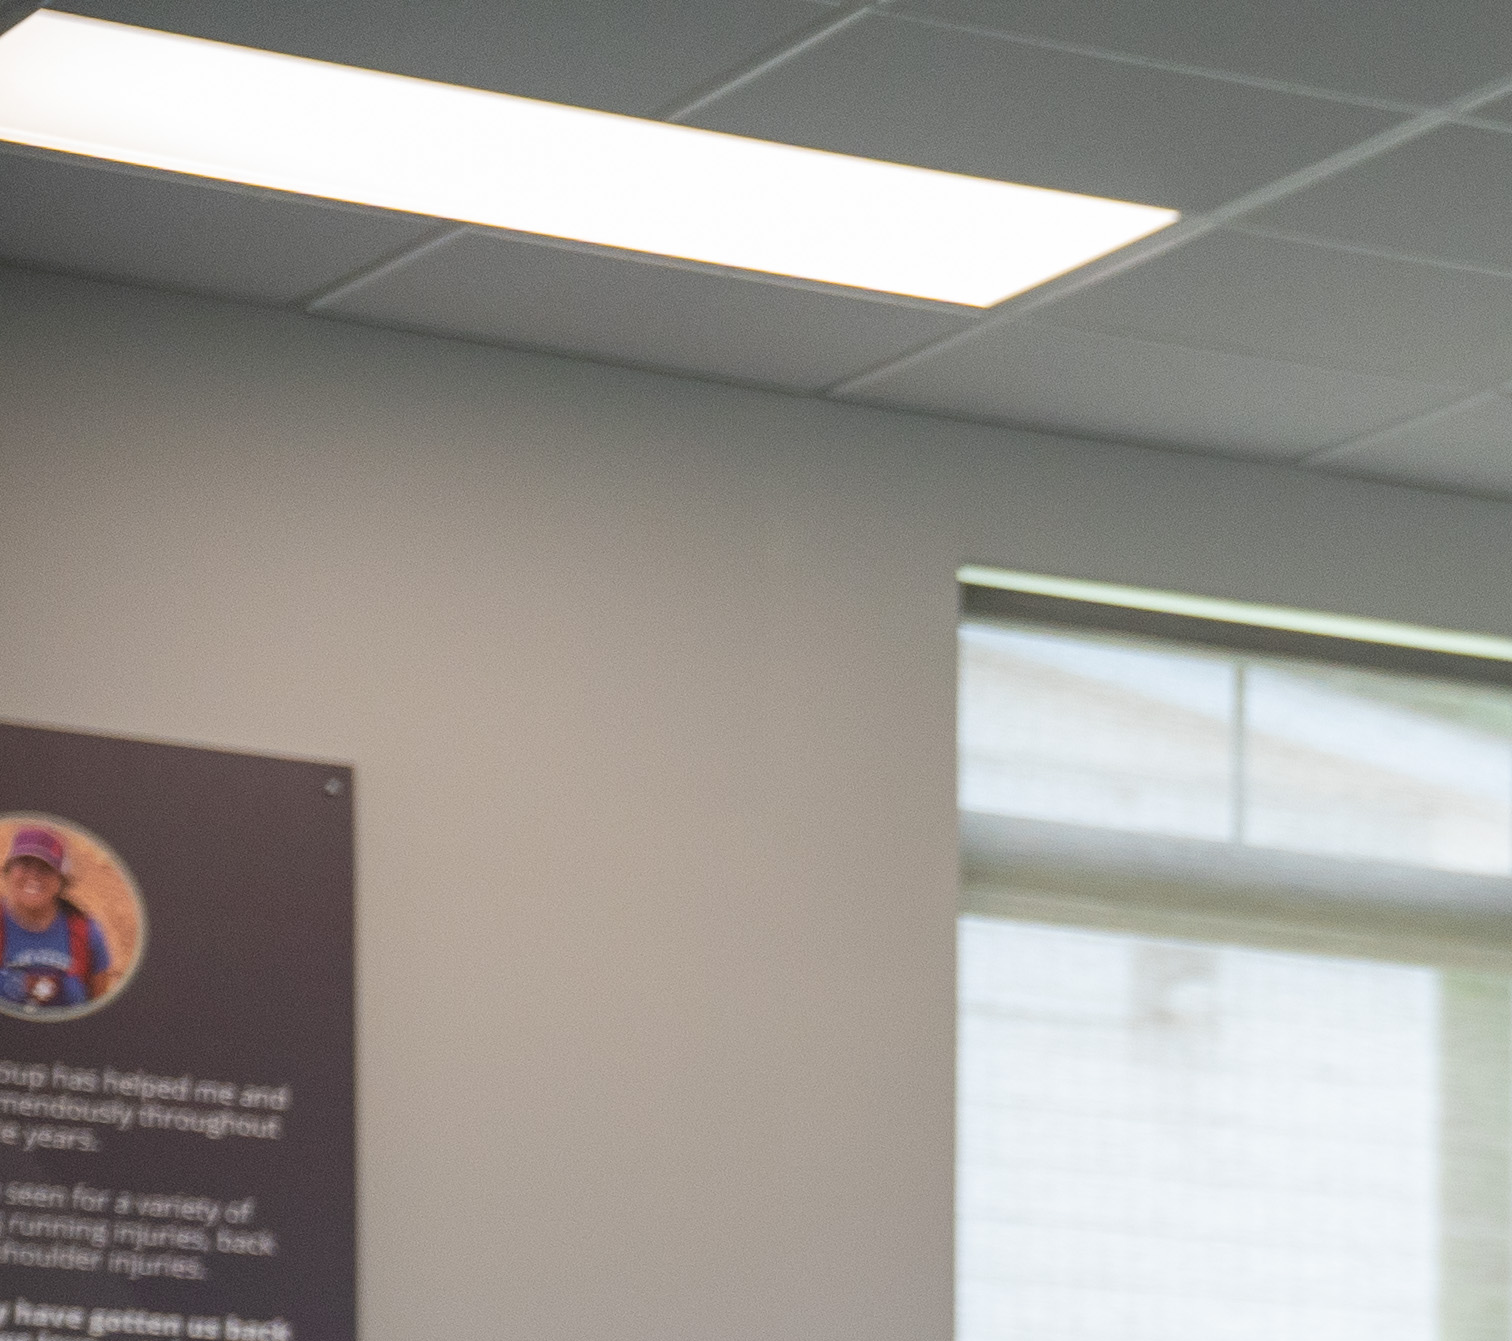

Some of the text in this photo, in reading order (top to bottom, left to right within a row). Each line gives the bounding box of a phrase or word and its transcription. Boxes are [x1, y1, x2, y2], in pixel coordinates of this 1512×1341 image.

[52, 1063, 98, 1092] has
[102, 1066, 192, 1101] helped
[195, 1081, 235, 1105] me
[239, 1086, 292, 1111] and
[138, 1105, 281, 1140] throughout
[5, 1183, 254, 1227] seen for a variety of
[8, 1213, 107, 1248] running
[215, 1226, 275, 1256] back
[14, 1299, 84, 1330] have
[87, 1307, 184, 1337] gotten
[186, 1315, 221, 1340] us
